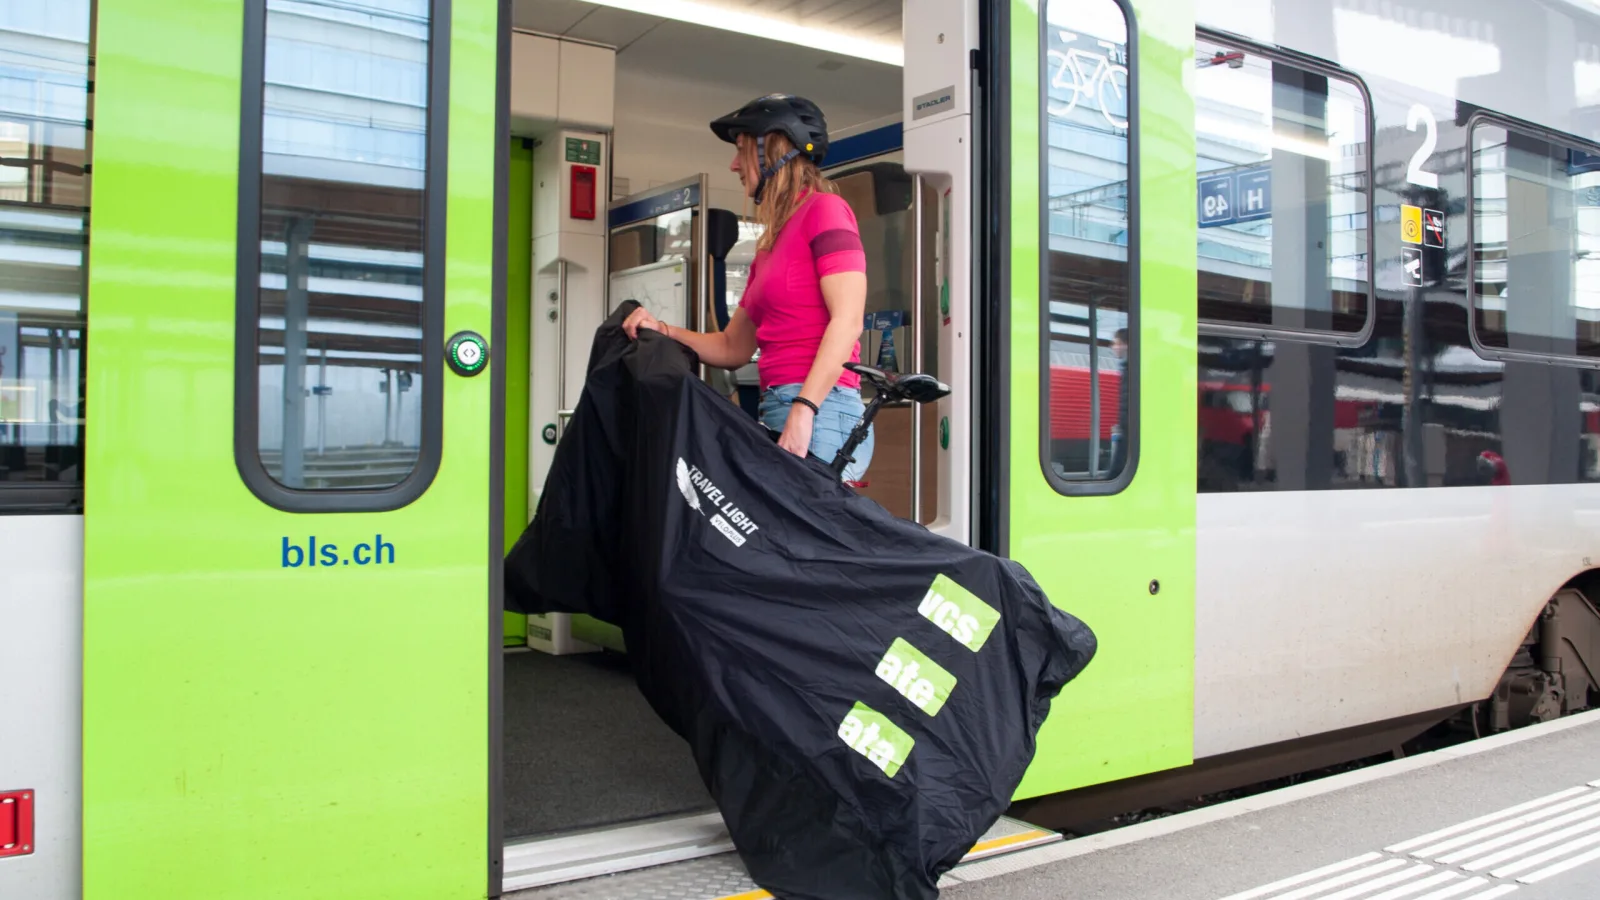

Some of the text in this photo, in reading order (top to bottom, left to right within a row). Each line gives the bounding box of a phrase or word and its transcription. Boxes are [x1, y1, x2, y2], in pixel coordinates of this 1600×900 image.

[917, 95, 951, 110] STADLER
[1406, 103, 1438, 189] 2
[683, 187, 691, 205] 2
[688, 465, 759, 535] TRAVEL LIGHT
[281, 534, 395, 568] bls.ch
[714, 516, 744, 544] VELOPLUS
[917, 588, 980, 646] vcs
[875, 653, 935, 710] ate
[838, 714, 895, 771] ata
